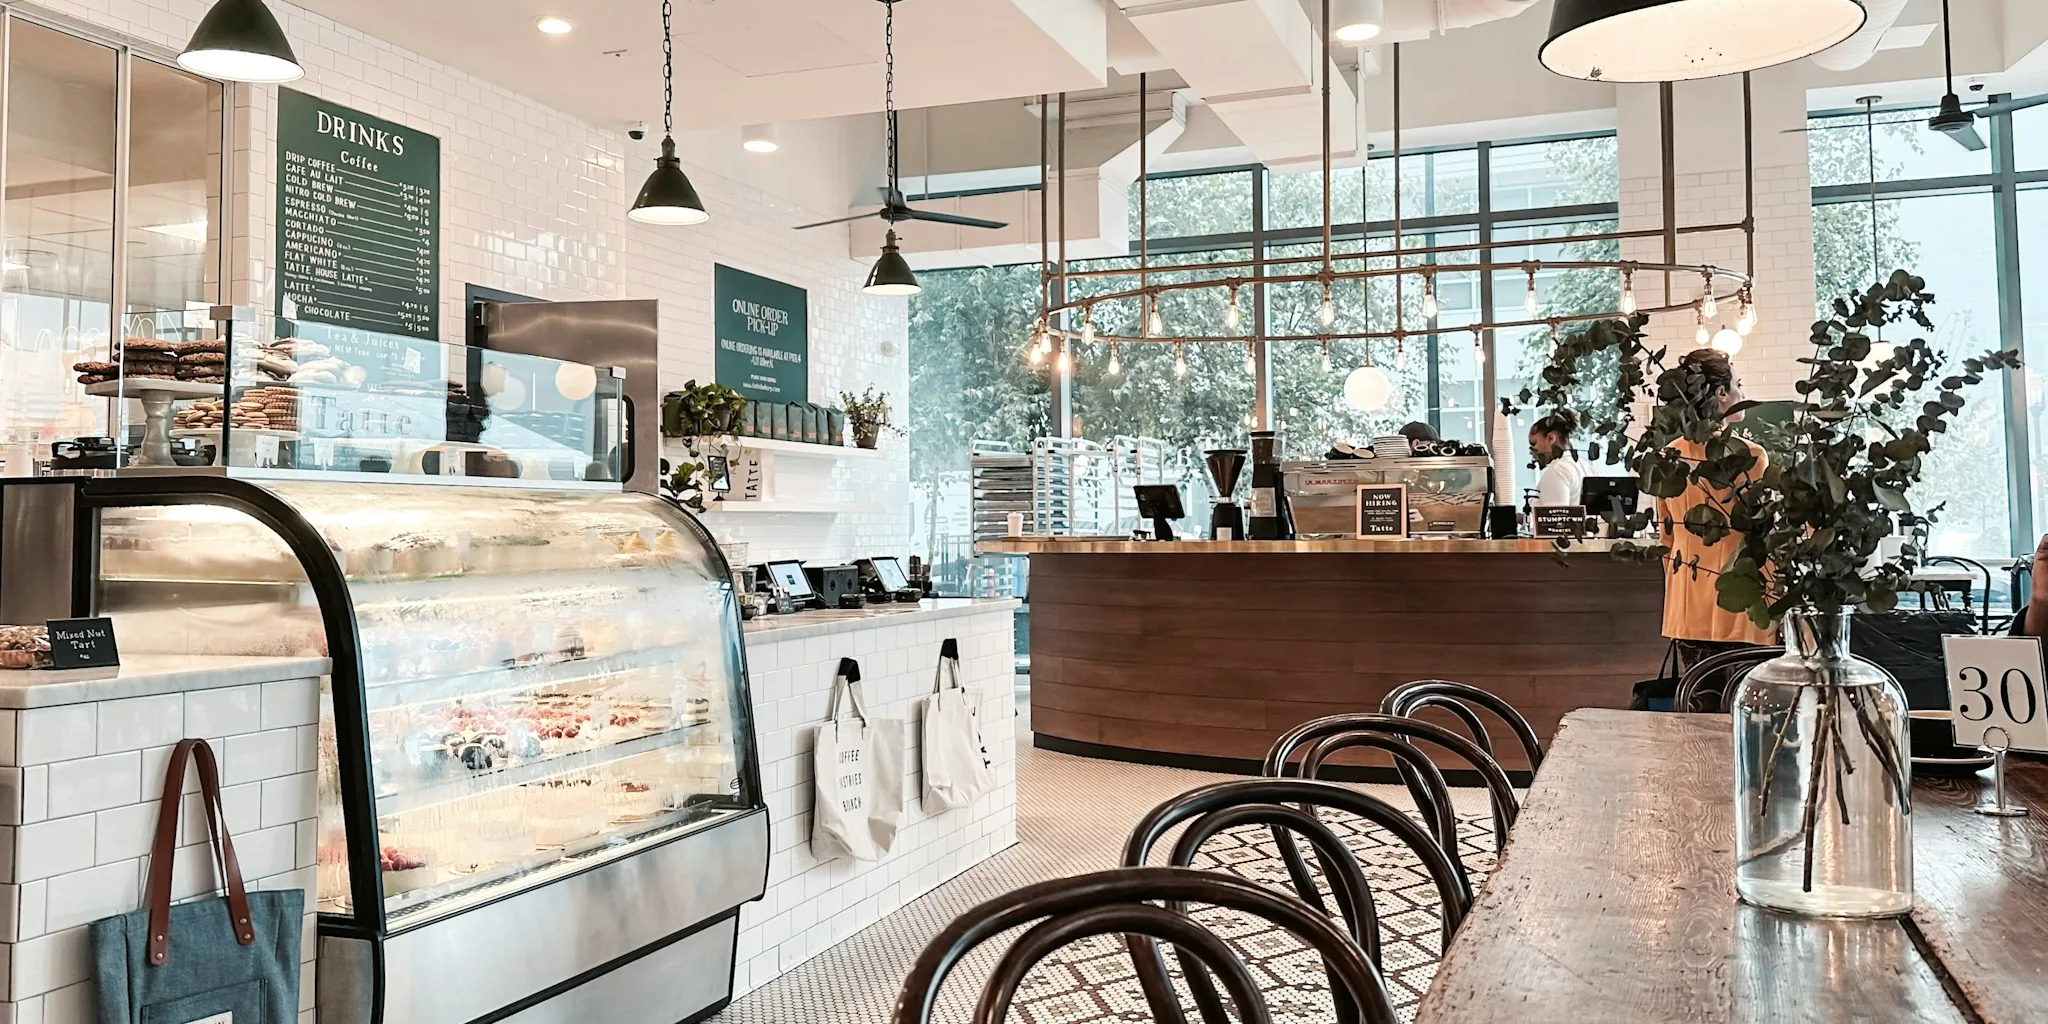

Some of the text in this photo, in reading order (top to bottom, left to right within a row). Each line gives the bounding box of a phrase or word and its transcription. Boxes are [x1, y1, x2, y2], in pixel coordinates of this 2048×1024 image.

[316, 111, 404, 156] DRINKS
[286, 151, 305, 163] DRIP
[308, 158, 336, 173] COFFEE
[340, 151, 379, 172] Coffee
[286, 163, 306, 176] CAFE
[310, 170, 320, 179] AU
[325, 174, 343, 185] LAIT
[286, 174, 308, 186] COLD
[312, 180, 334, 193] BREW
[285, 184, 310, 198] NITRO
[313, 192, 332, 202] COLD
[335, 196, 356, 209] BREW
[285, 196, 326, 213] ESPRESSO
[285, 207, 336, 226] MACCHIATO
[285, 220, 324, 234] CORTADO
[285, 229, 334, 248] CAPPUCINO
[284, 251, 306, 262] FLAT
[309, 256, 338, 269] WHITE
[284, 261, 312, 274] TATTE
[316, 268, 338, 280] HOUSE
[304, 305, 350, 320] CHOCOLATE
[732, 298, 788, 326] ONLINE ORDER
[747, 316, 779, 336] PICK-UP
[326, 326, 400, 349] Tea & Juices
[334, 344, 352, 354] MEM
[720, 338, 736, 352] ONLINE
[736, 342, 757, 356] ORDERING
[762, 347, 783, 360] AVAILABLE
[310, 395, 412, 436] Tatte
[745, 460, 758, 500] TATTE
[1370, 524, 1394, 532] Tatte
[56, 628, 106, 640] Mixed Nut
[70, 640, 96, 650] Tart
[1959, 666, 2036, 724] 30
